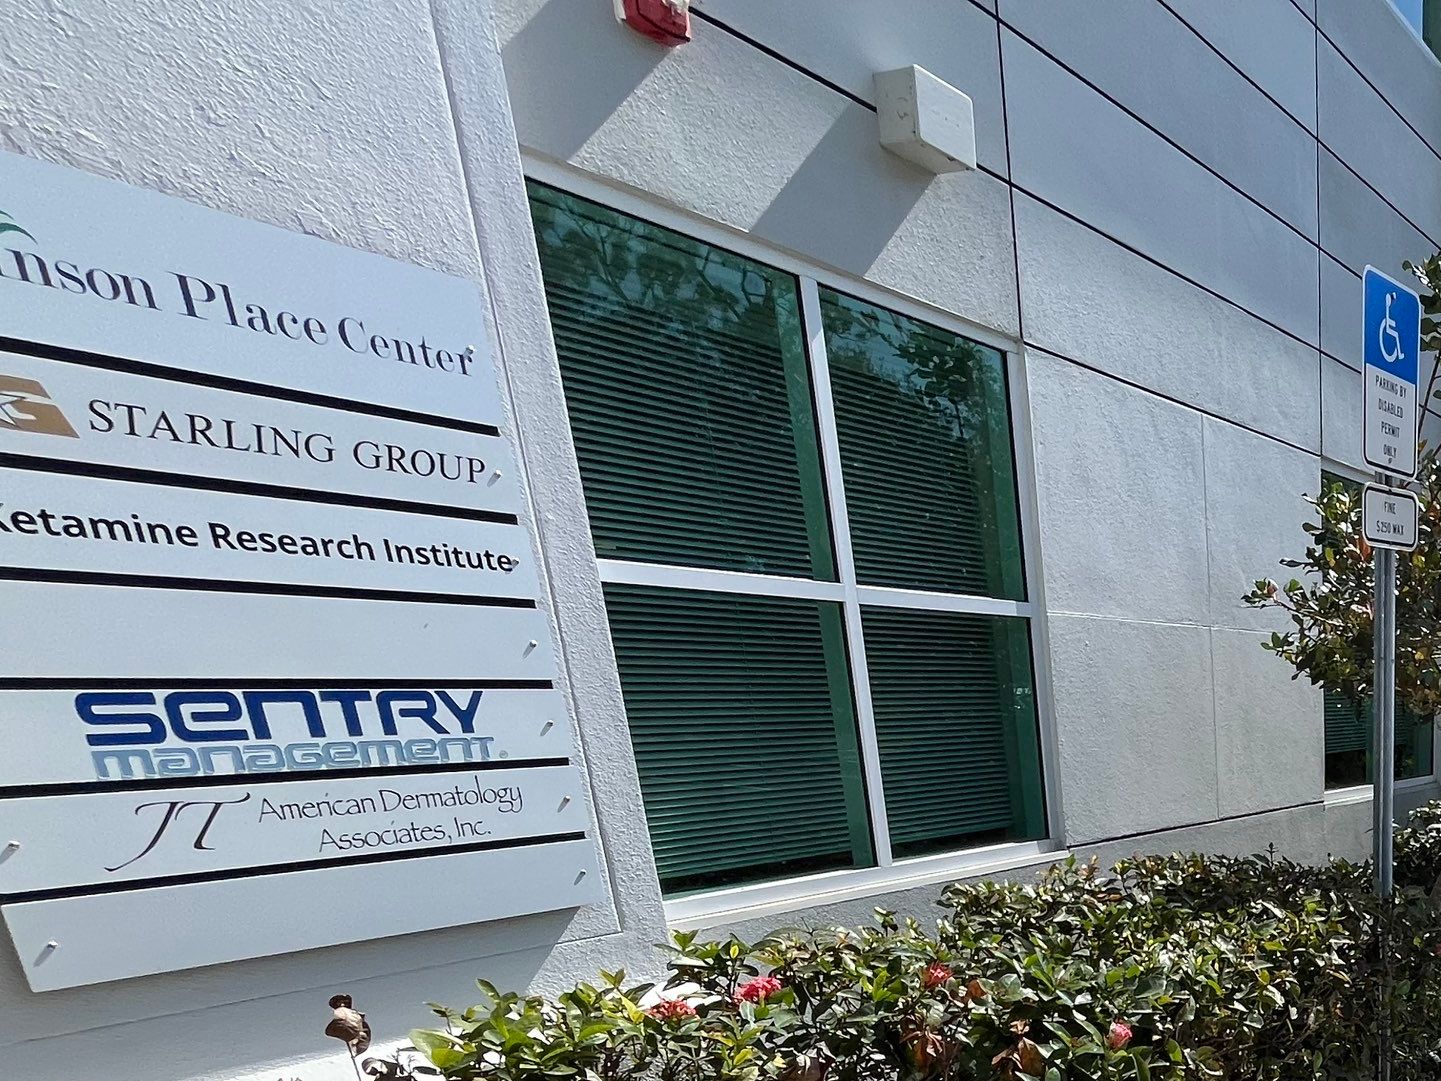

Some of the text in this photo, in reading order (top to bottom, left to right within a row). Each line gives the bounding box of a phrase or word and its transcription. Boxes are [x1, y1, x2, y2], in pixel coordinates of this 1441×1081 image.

[0, 247, 474, 377] nson Place Center
[1376, 374, 1407, 398] PARKING BY
[1378, 398, 1404, 418] DISABLED
[88, 399, 486, 484] STARLING GROUP
[1381, 421, 1400, 438] PERMIT
[1383, 444, 1397, 458] ONLY
[1384, 501, 1396, 515] FINE
[1376, 520, 1391, 534] $250
[206, 521, 376, 563] Research
[383, 538, 514, 573] Institute
[258, 775, 524, 823] American Dermatology
[318, 817, 492, 853] Associates, Inc.
